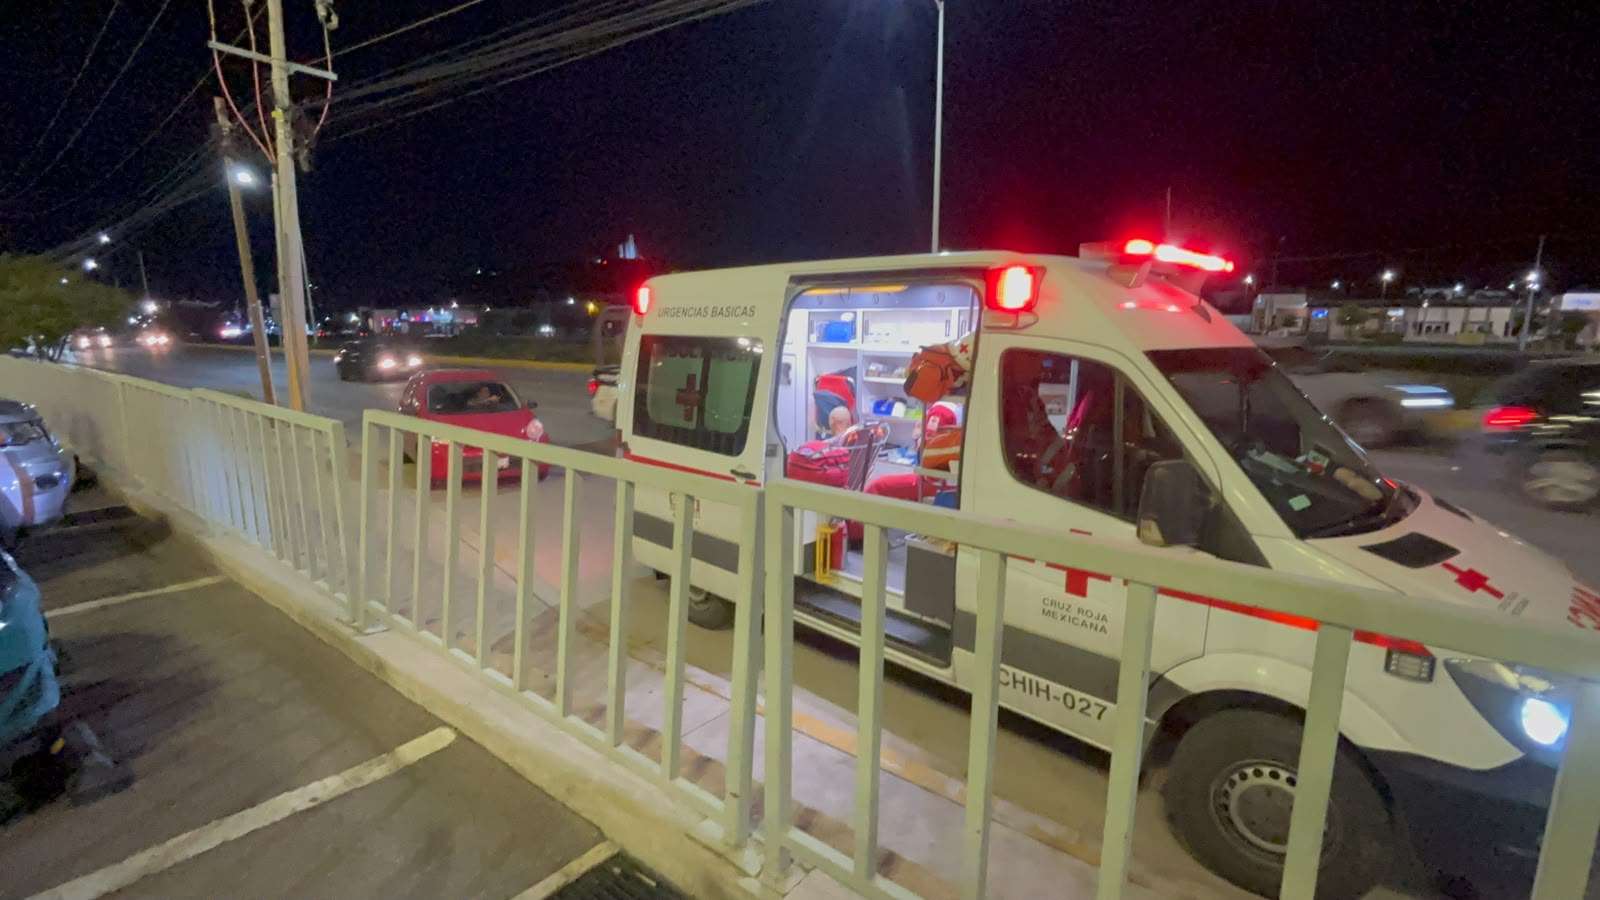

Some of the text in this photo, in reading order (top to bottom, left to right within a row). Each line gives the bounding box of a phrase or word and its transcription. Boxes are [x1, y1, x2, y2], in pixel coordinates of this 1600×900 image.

[657, 305, 756, 318] URGENCIAS BASICAS
[1042, 597, 1108, 622] CRUZ ROJA
[1042, 608, 1108, 634] MEXICANA
[999, 668, 1107, 720] CHIH-027
